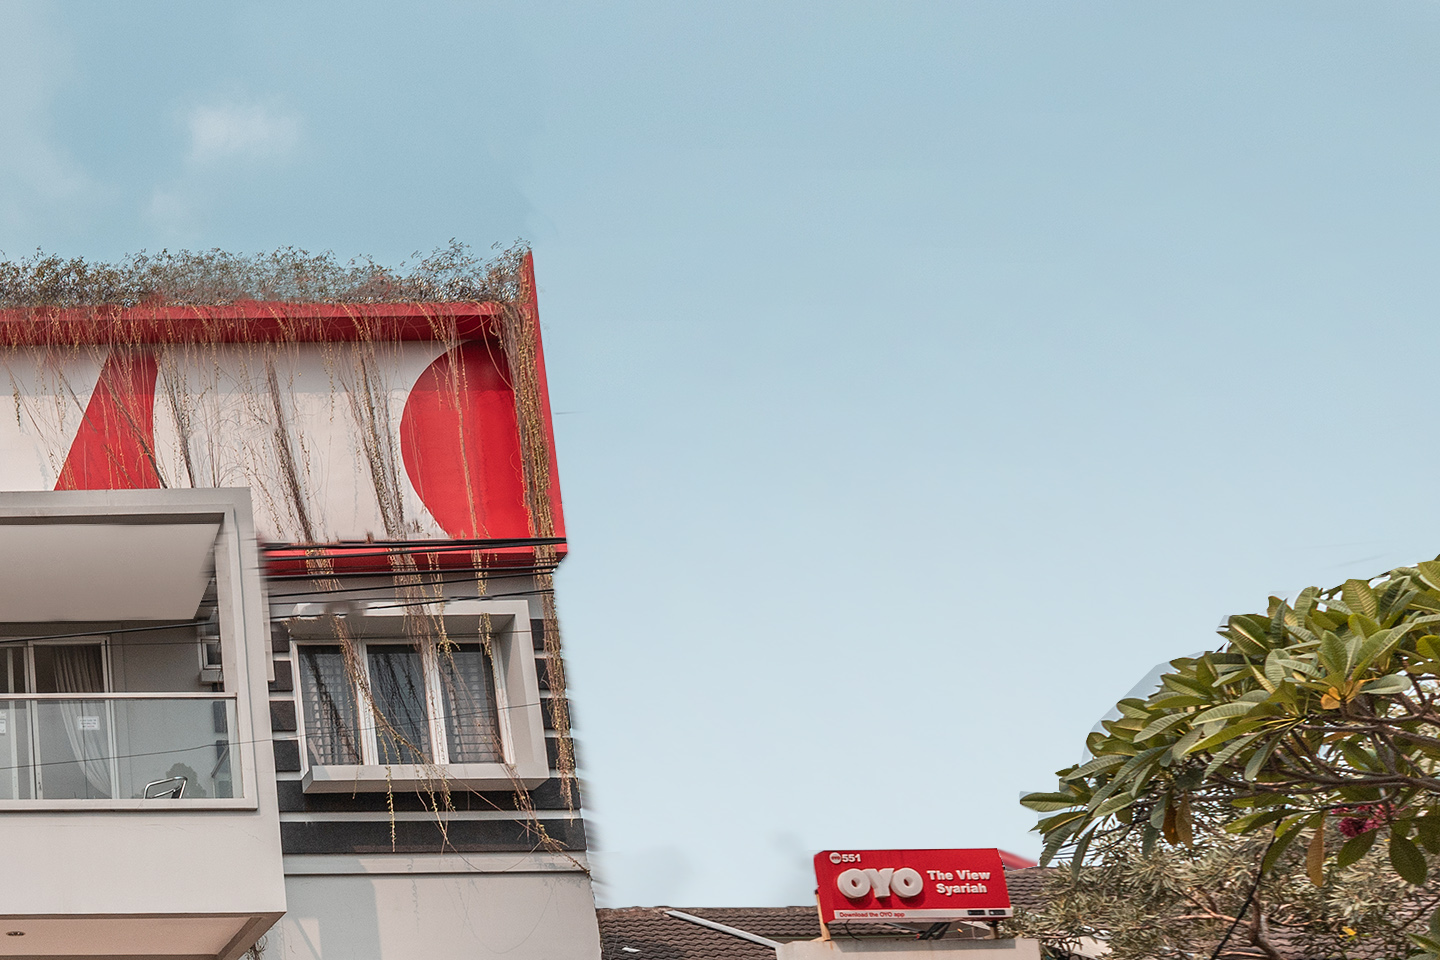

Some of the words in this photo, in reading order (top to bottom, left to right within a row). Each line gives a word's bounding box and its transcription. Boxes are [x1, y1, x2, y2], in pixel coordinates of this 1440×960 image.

[842, 853, 861, 863] 551
[926, 870, 954, 880] The
[955, 869, 991, 880] View
[837, 868, 924, 898] OYO
[936, 883, 988, 896] Syariah
